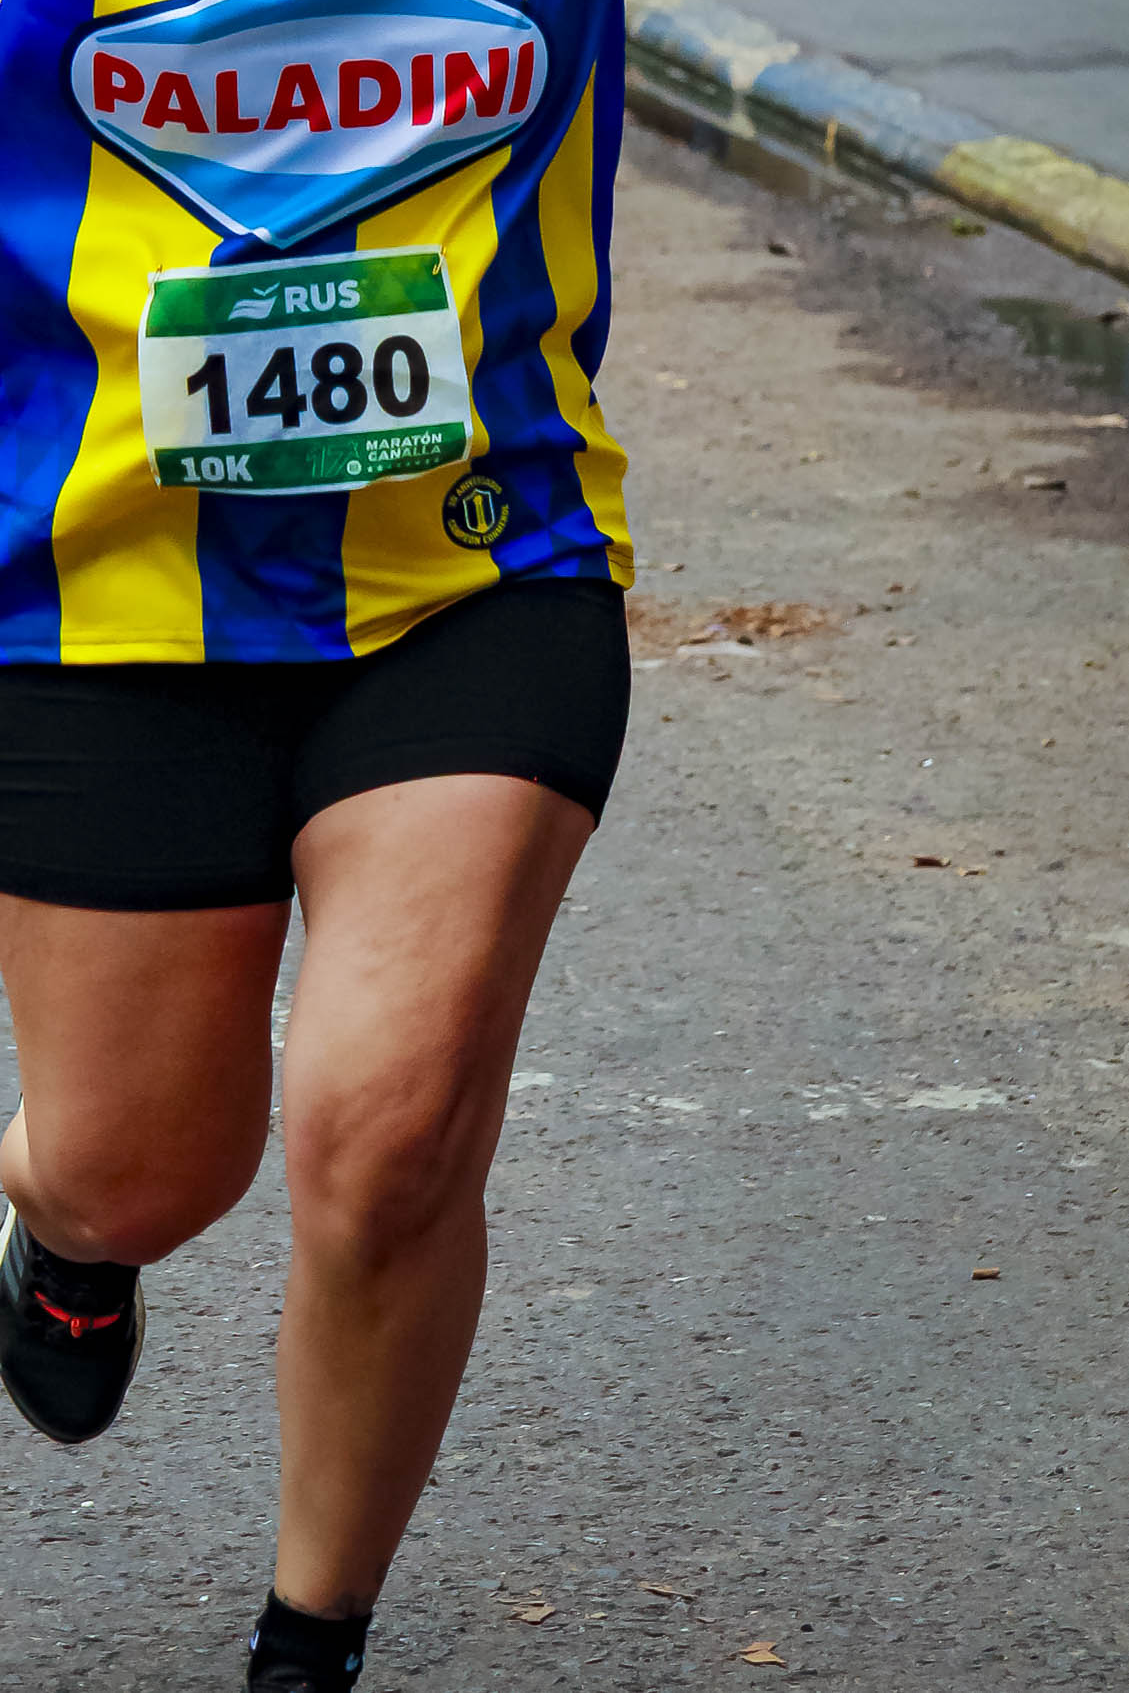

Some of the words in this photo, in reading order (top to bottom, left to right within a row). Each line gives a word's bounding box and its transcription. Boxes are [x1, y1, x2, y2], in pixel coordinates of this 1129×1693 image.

[93, 41, 535, 134] PALADINI
[284, 279, 361, 314] RUS
[187, 335, 430, 435] 1480
[366, 430, 443, 451] MARATÓN
[368, 444, 441, 462] CANALLA
[180, 454, 253, 483] 10K
